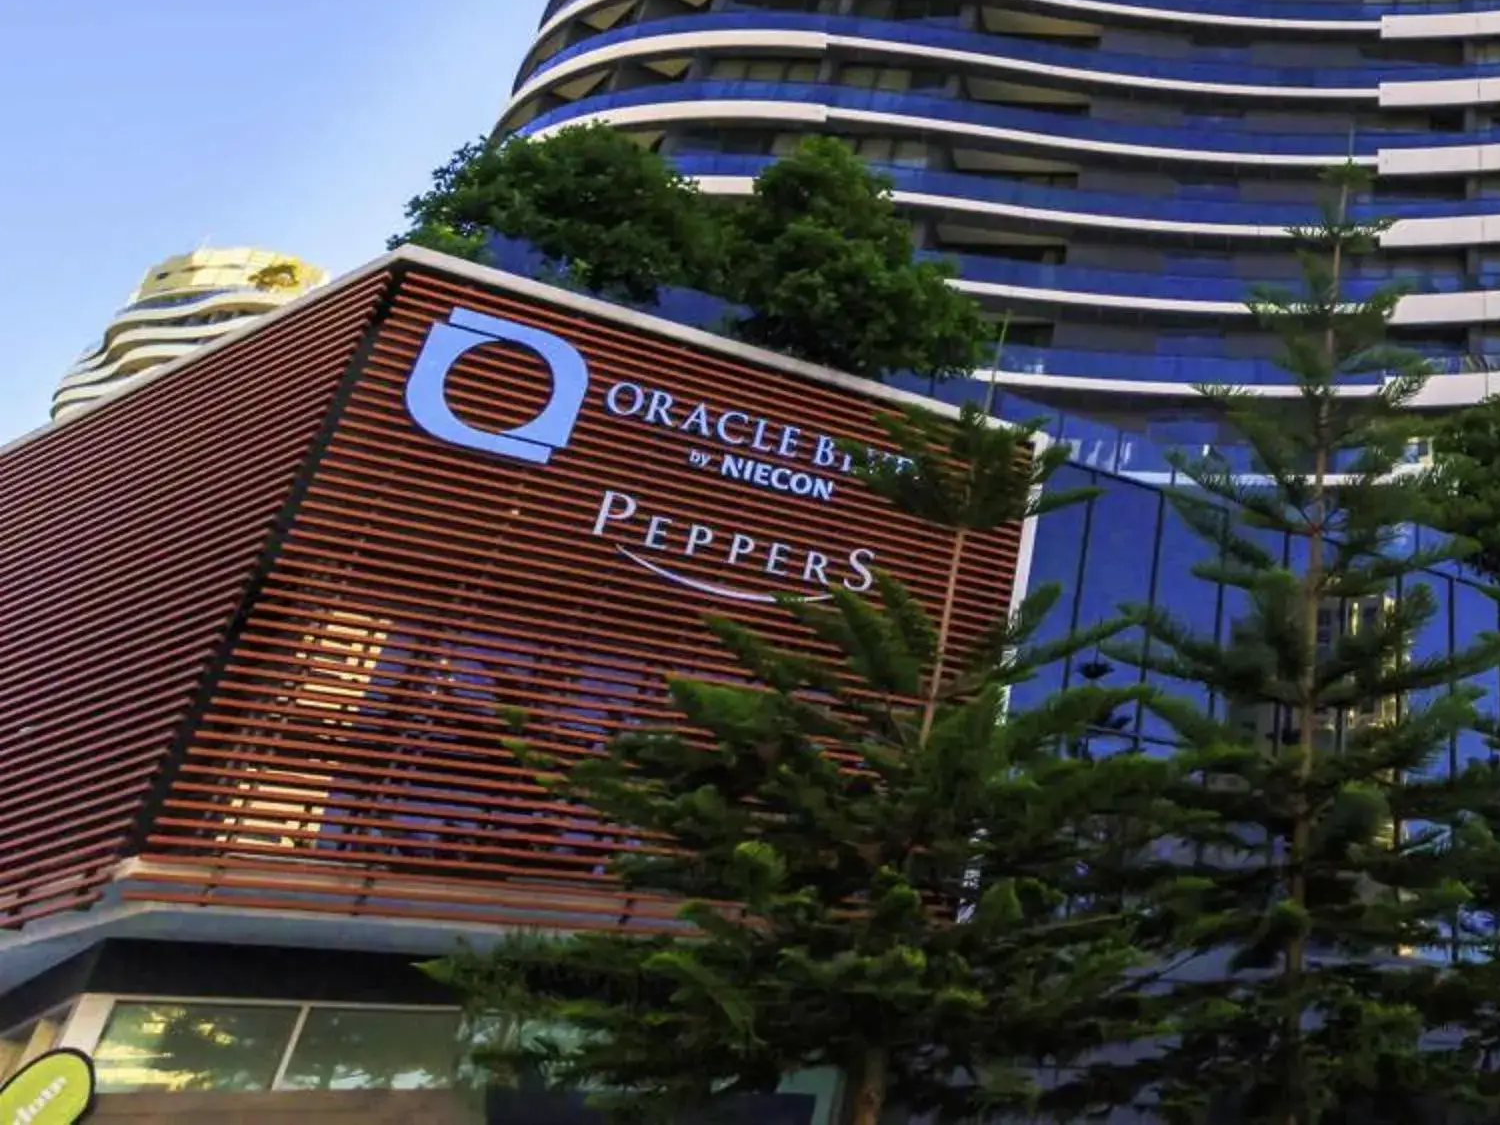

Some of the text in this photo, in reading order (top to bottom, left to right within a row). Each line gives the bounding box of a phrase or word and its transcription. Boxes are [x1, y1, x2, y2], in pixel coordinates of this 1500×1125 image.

[606, 381, 801, 458] ORACLE
[688, 448, 834, 501] by NIECON
[591, 489, 876, 592] PEPPERS
